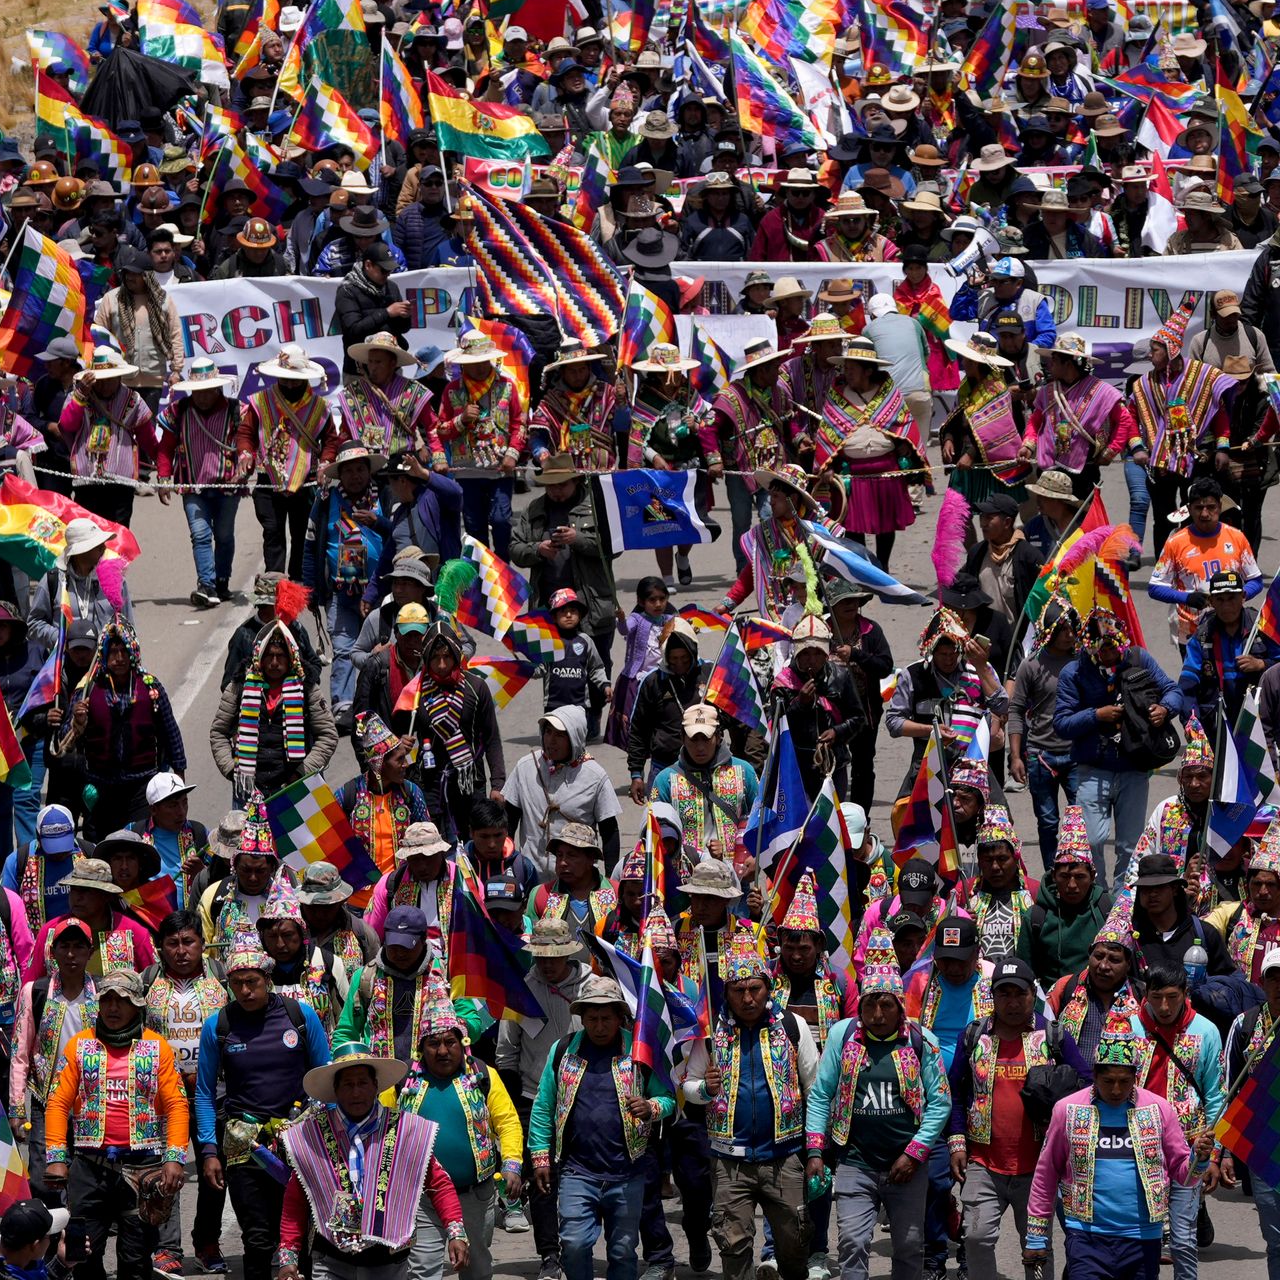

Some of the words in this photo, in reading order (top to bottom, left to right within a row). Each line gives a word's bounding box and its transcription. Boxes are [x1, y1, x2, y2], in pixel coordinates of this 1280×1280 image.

[552, 667, 582, 675] QATAR
[43, 885, 59, 896] LUE
[172, 1000, 197, 1023] 16
[868, 1109, 880, 1117] LIVE
[1096, 1134, 1133, 1149] ebo
